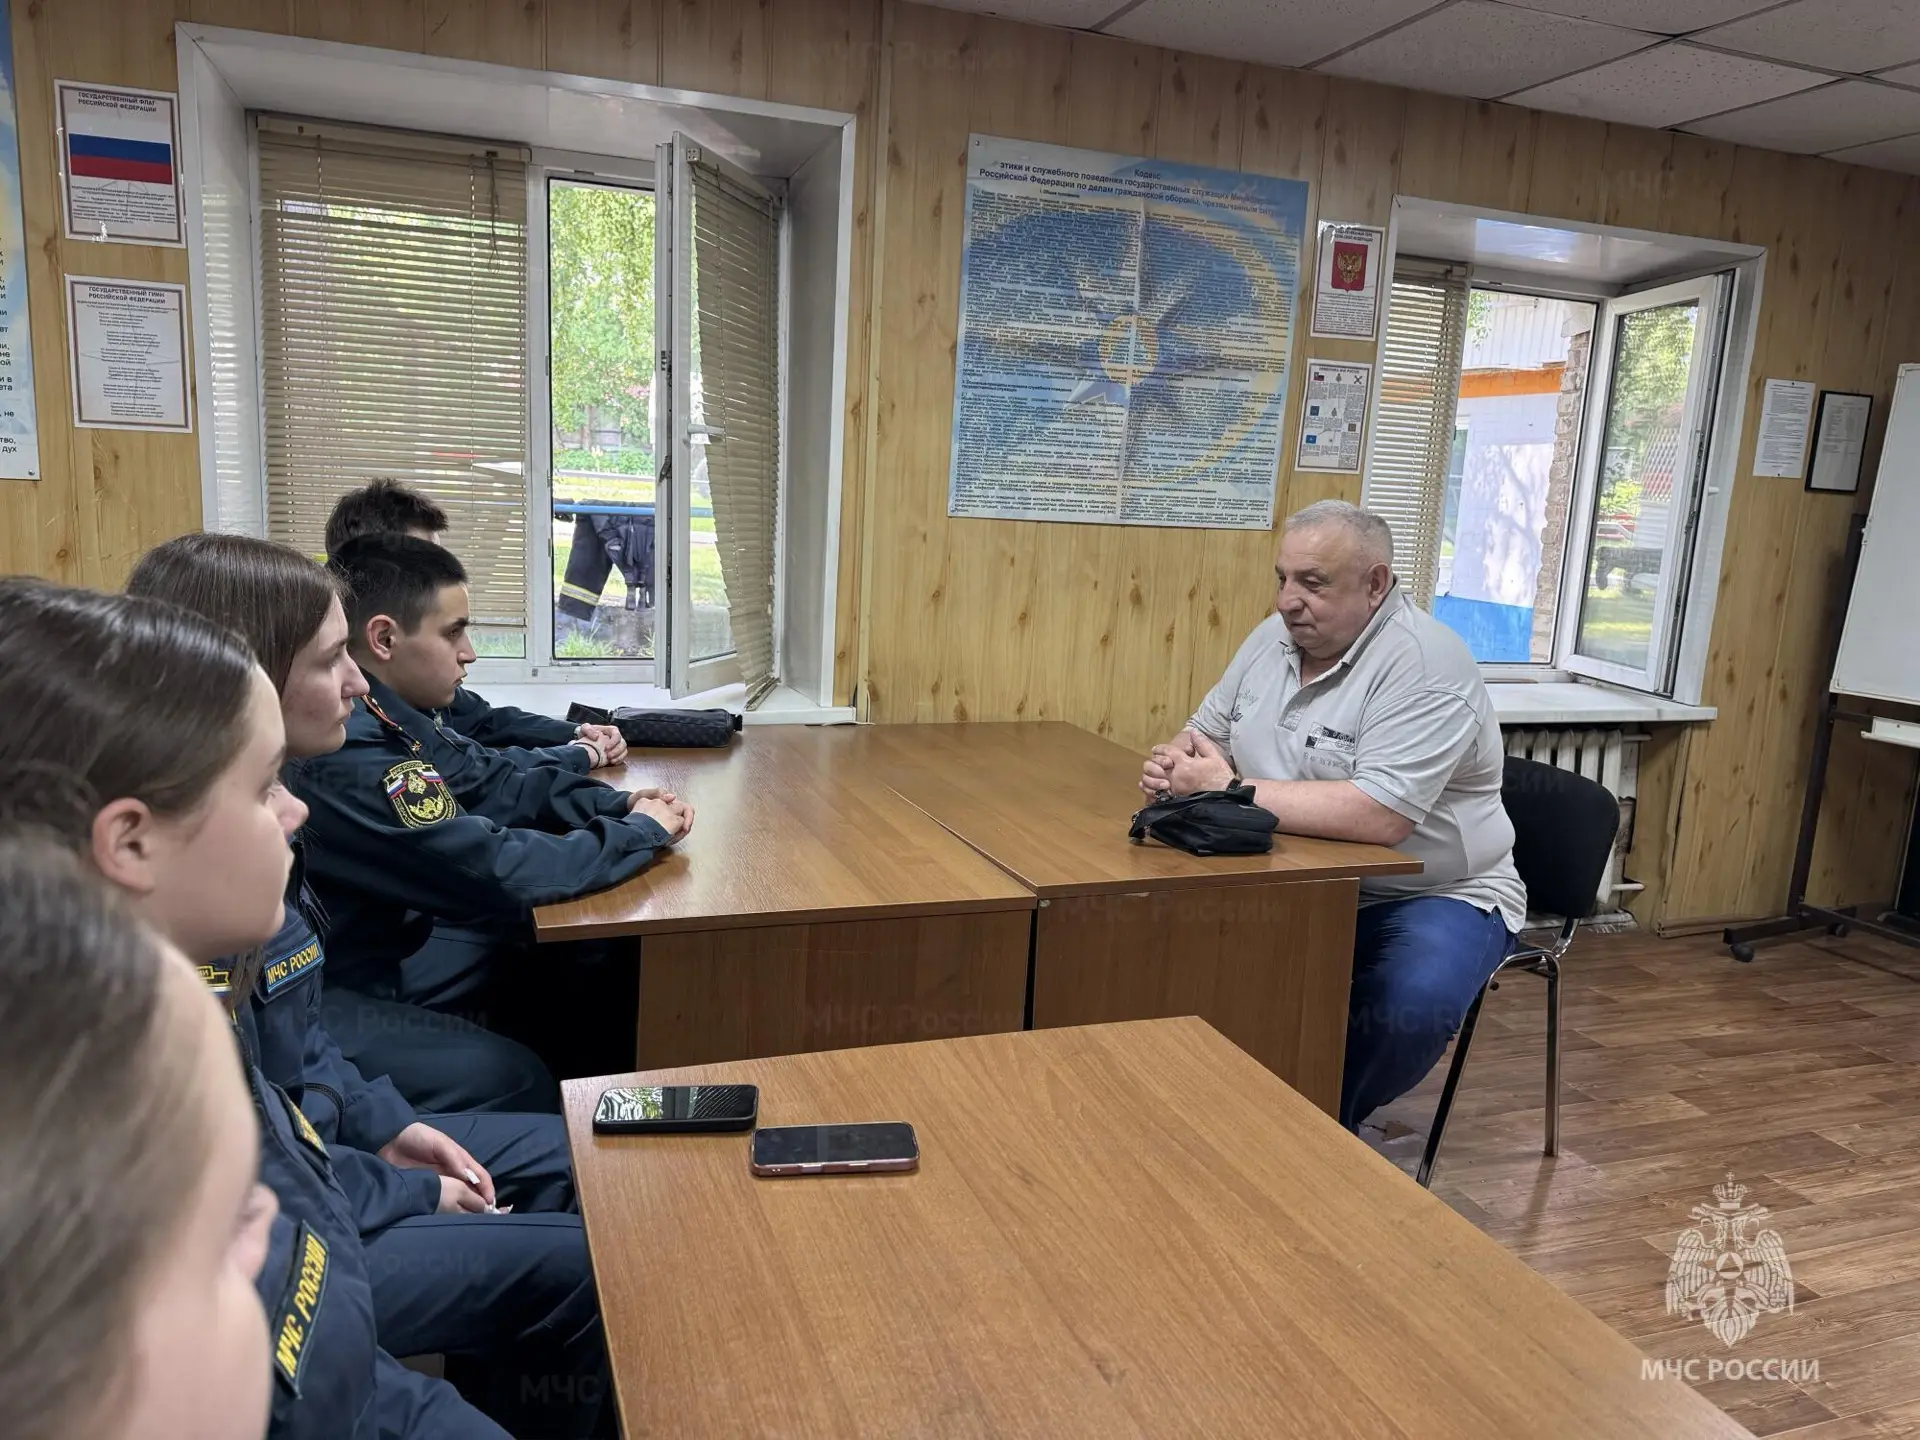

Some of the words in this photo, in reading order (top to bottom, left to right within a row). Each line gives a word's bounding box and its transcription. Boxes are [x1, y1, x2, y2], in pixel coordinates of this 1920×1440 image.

[78, 91, 138, 104] ГОСУДАРСТВЕННЫЙ
[78, 98, 118, 108] РОССИЙСКОЙ
[119, 103, 157, 112] ФЕДЕРАЦИИ
[1000, 162, 1023, 171] этики
[1032, 166, 1080, 179] служебного
[1081, 173, 1123, 185] поведения
[1124, 179, 1190, 194] государственных
[1134, 168, 1161, 180] Кодекс
[979, 168, 1028, 182] Российской
[1030, 175, 1075, 188] Федерации
[1088, 184, 1114, 193] делам
[1115, 187, 1164, 200] гражданской
[88, 286, 147, 296] ГОСУДАРСТВЕННЫЙ
[88, 293, 128, 301] РОССИЙСКОЙ
[129, 296, 166, 304] ФЕДЕРАЦИИ
[267, 961, 288, 985] МЧС
[289, 942, 320, 973] РОССИИ
[276, 1314, 303, 1378] МЧС
[294, 1233, 327, 1322] РОССИИ
